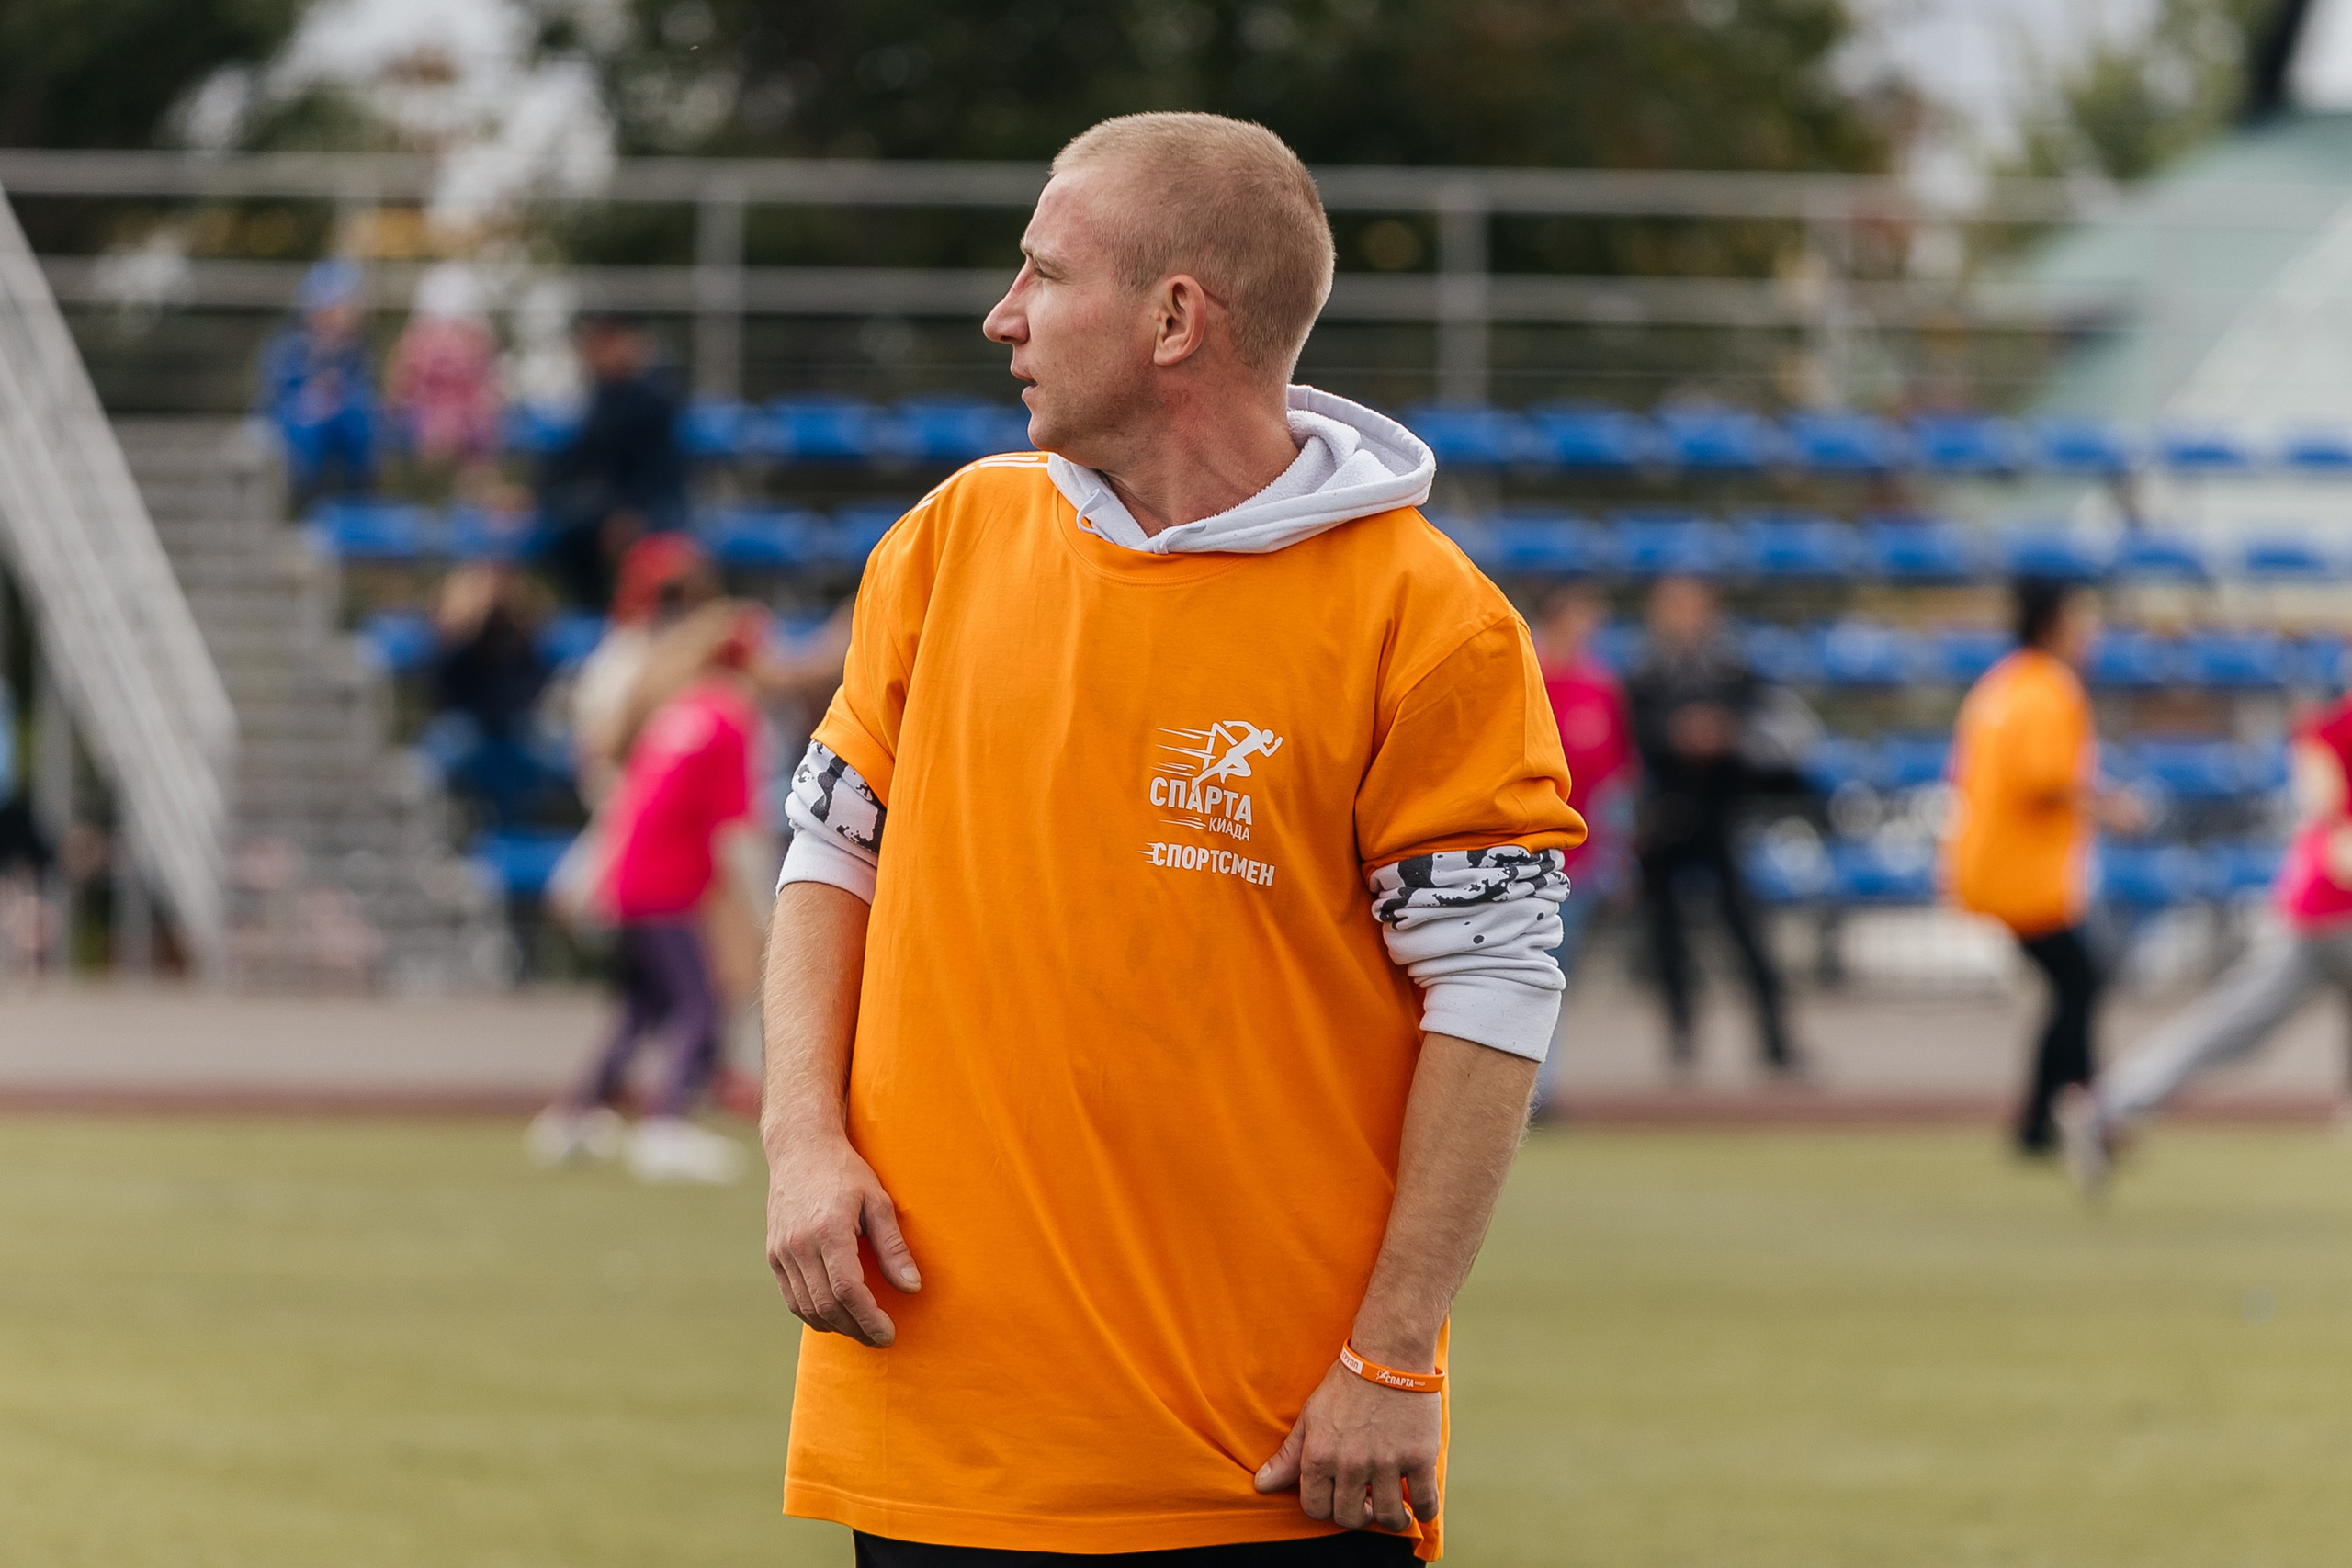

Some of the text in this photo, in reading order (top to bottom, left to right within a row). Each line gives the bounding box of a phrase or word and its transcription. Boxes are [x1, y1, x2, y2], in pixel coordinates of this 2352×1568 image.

[1149, 776, 1253, 826] СПАРТА
[1208, 817, 1250, 842] КИАДА
[1151, 841, 1275, 887] СПОРТСМЕН
[1385, 1374, 1415, 1388] СПАРТА
